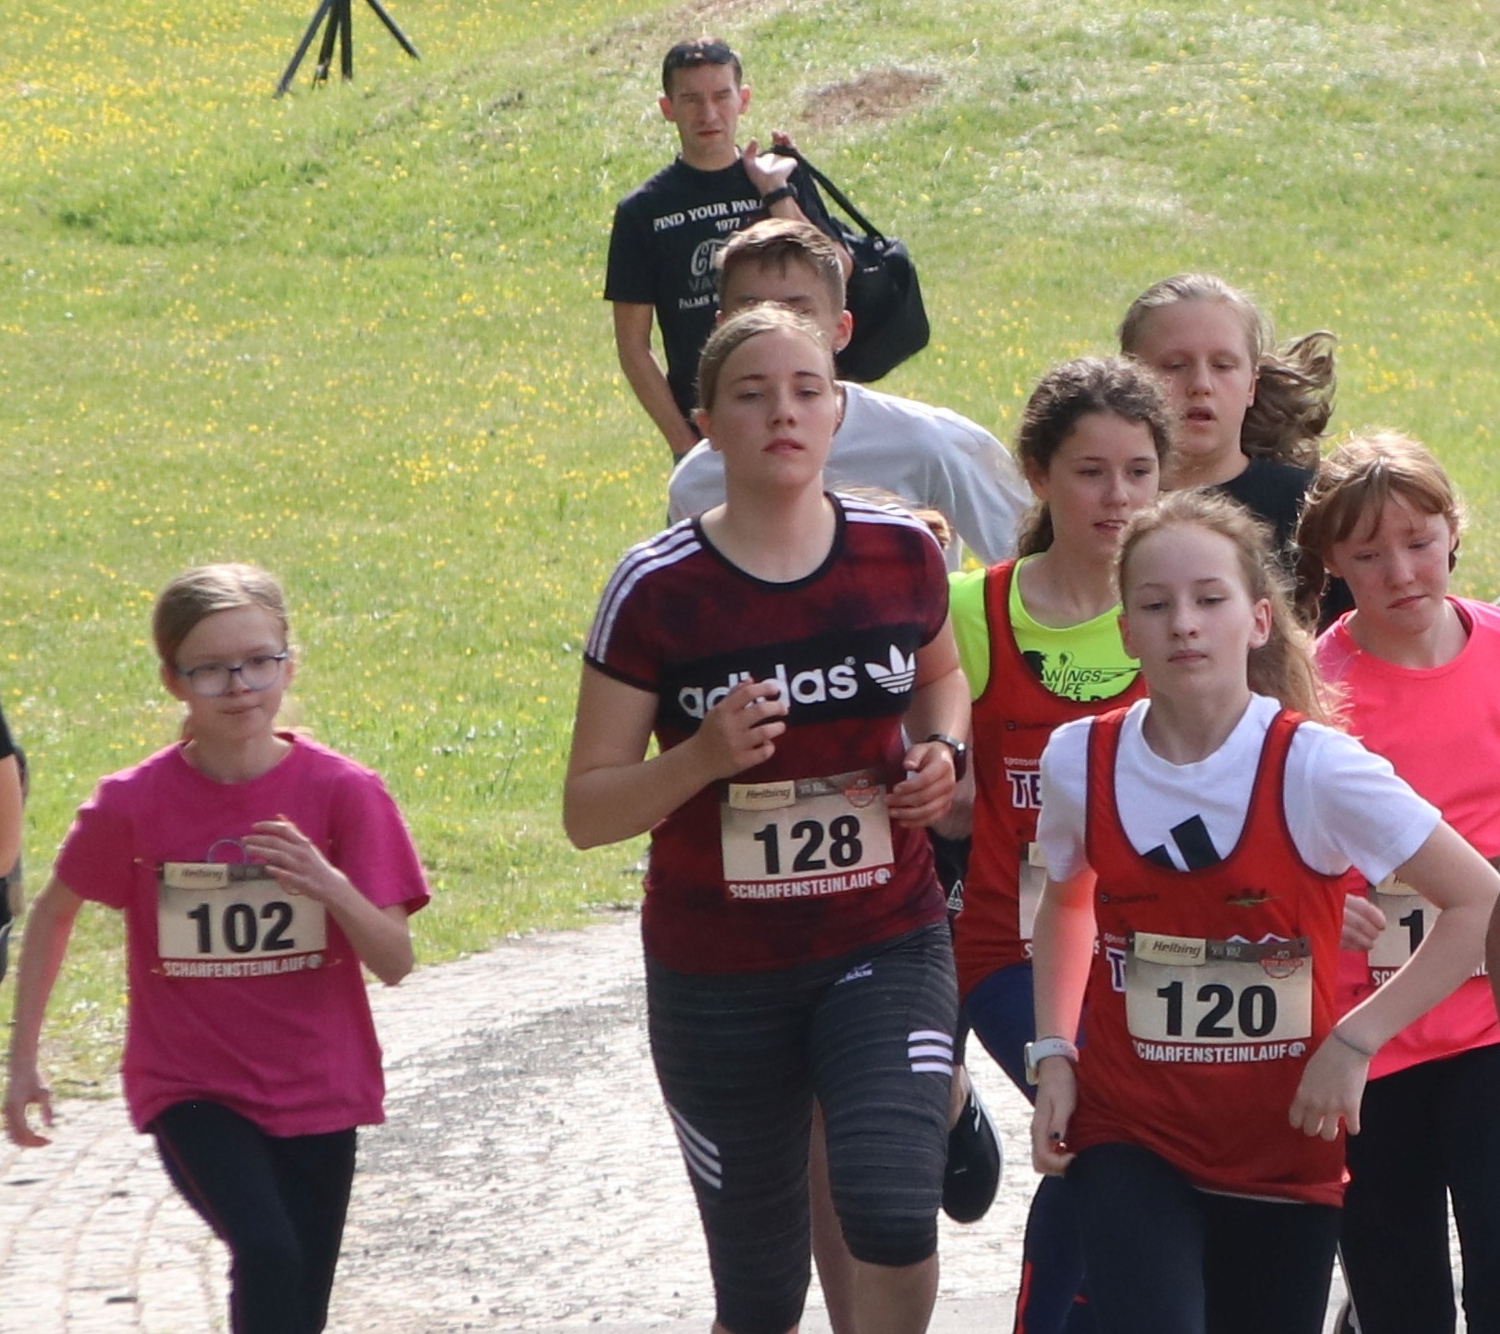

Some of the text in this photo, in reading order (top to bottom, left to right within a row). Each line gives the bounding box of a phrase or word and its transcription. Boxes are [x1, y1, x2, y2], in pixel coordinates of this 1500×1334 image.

[653, 213, 685, 232] FIND
[688, 203, 729, 222] YOUR
[715, 217, 741, 231] 1977
[753, 815, 863, 875] 128
[729, 872, 874, 899] SCHARFENSTEINLAUF
[187, 901, 295, 954] 102
[1152, 940, 1202, 957] Helbing
[163, 957, 306, 978] SCHARFENSTEINLAUF
[1157, 981, 1277, 1038] 120
